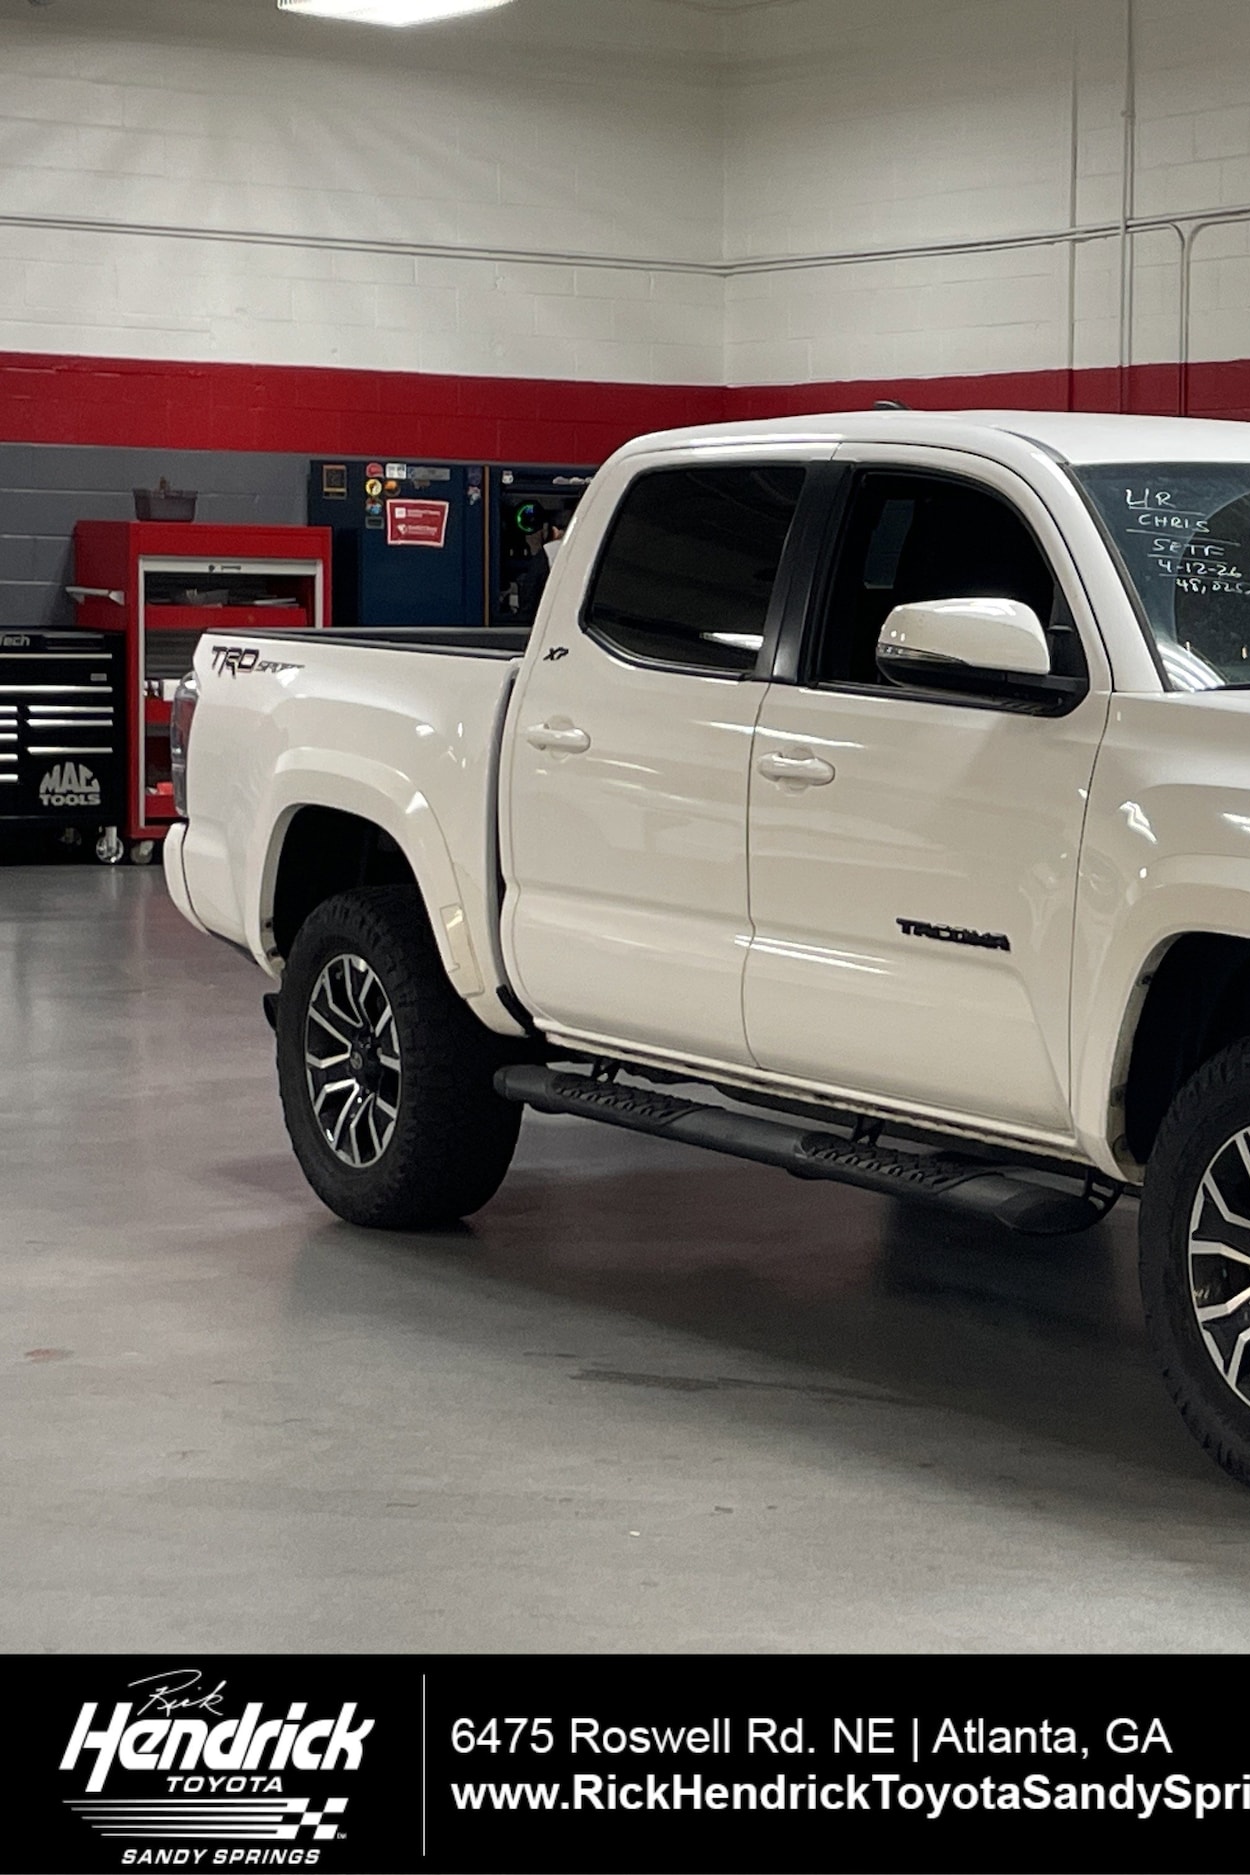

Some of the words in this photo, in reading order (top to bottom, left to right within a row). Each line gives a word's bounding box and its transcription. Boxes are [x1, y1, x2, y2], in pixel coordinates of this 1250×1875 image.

[1138, 514, 1210, 533] CHRIS
[212, 645, 260, 680] TRD
[543, 646, 569, 661] XP
[39, 761, 101, 794] MAC
[39, 793, 101, 806] TOOLS
